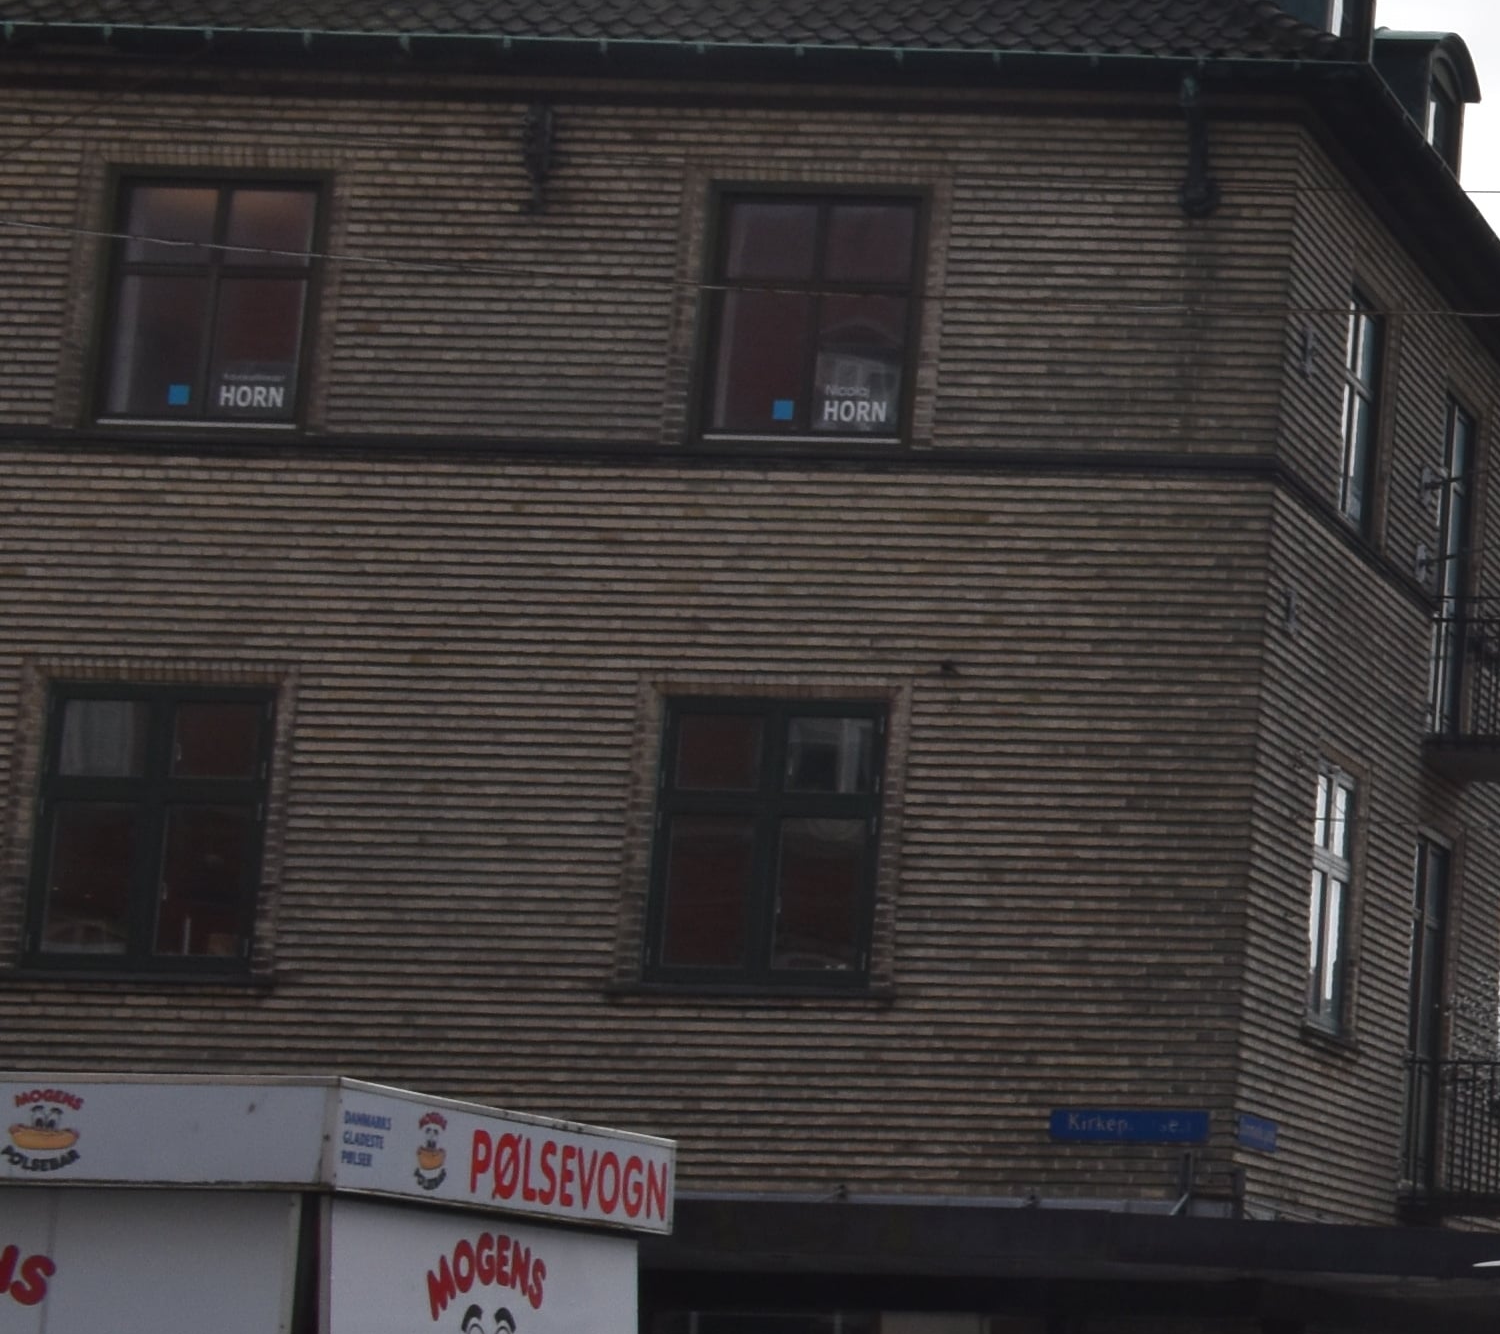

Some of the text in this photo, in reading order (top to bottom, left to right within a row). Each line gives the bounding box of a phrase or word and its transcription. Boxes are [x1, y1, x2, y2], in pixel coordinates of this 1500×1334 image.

[220, 384, 284, 408] HORN
[823, 399, 887, 422] HORN
[15, 1088, 84, 1111] MOGENS
[344, 1110, 392, 1131] DANMARKS
[343, 1130, 384, 1150] GLADESTE
[1, 1145, 80, 1172] PØLSEBAR
[470, 1129, 668, 1222] PØLSEVOGN
[426, 1231, 547, 1321] MOGENS
